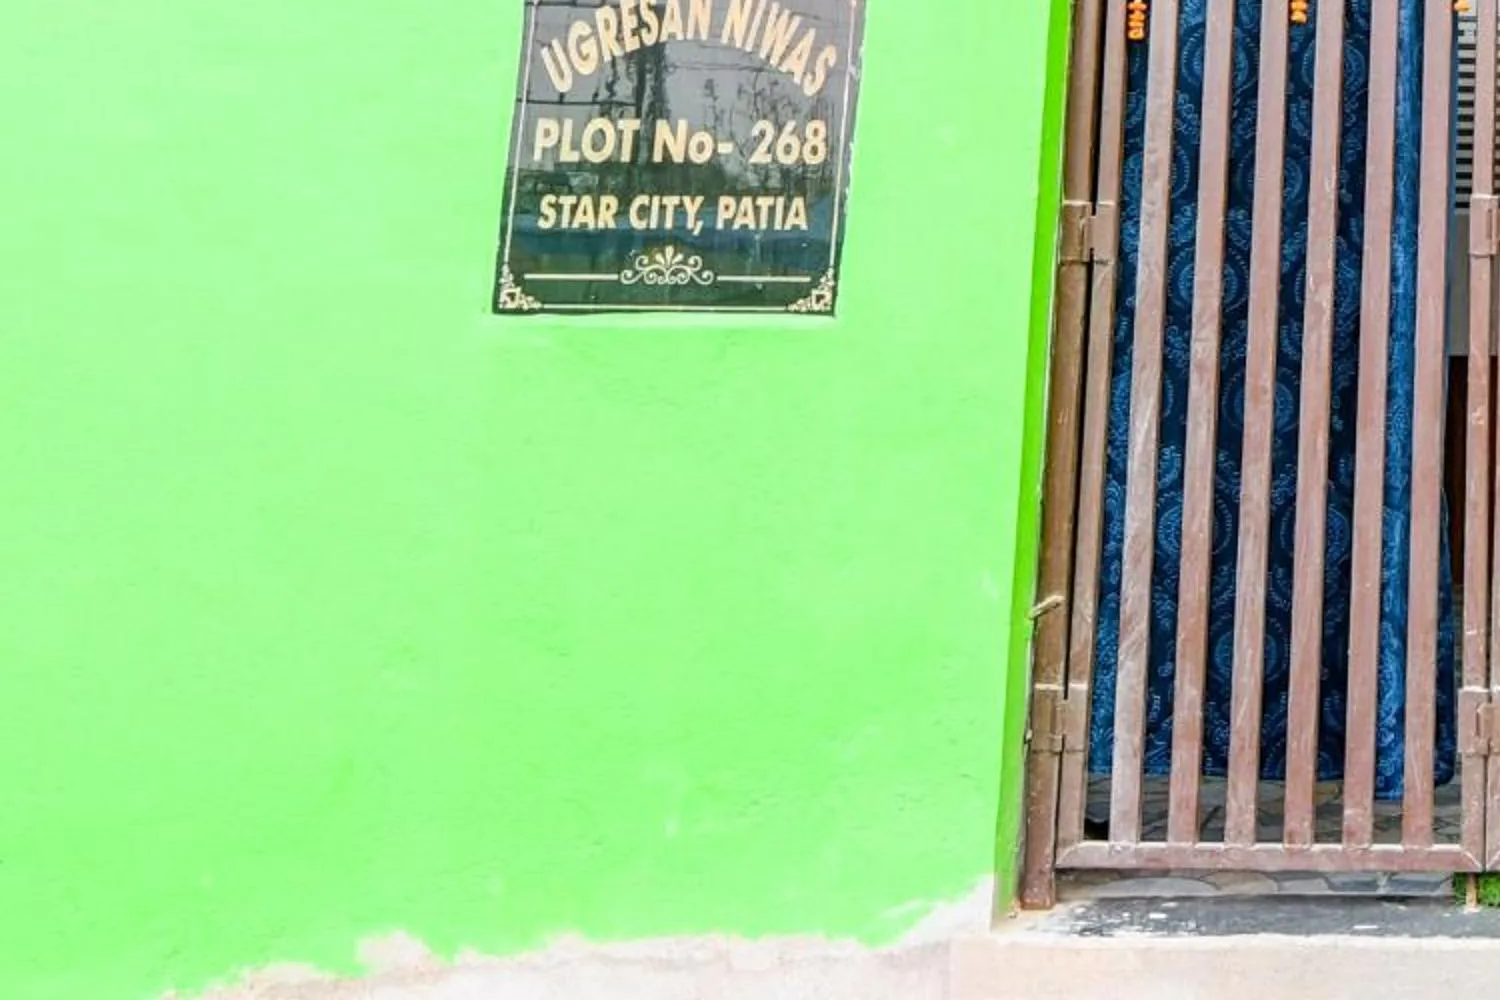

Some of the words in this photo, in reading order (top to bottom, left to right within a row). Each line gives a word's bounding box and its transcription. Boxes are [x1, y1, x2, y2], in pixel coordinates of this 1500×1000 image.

[532, 117, 641, 162] PLOT
[749, 119, 827, 165] 268
[537, 194, 617, 230] STAR
[629, 194, 704, 235] CITY,
[716, 196, 808, 231] PATIA
